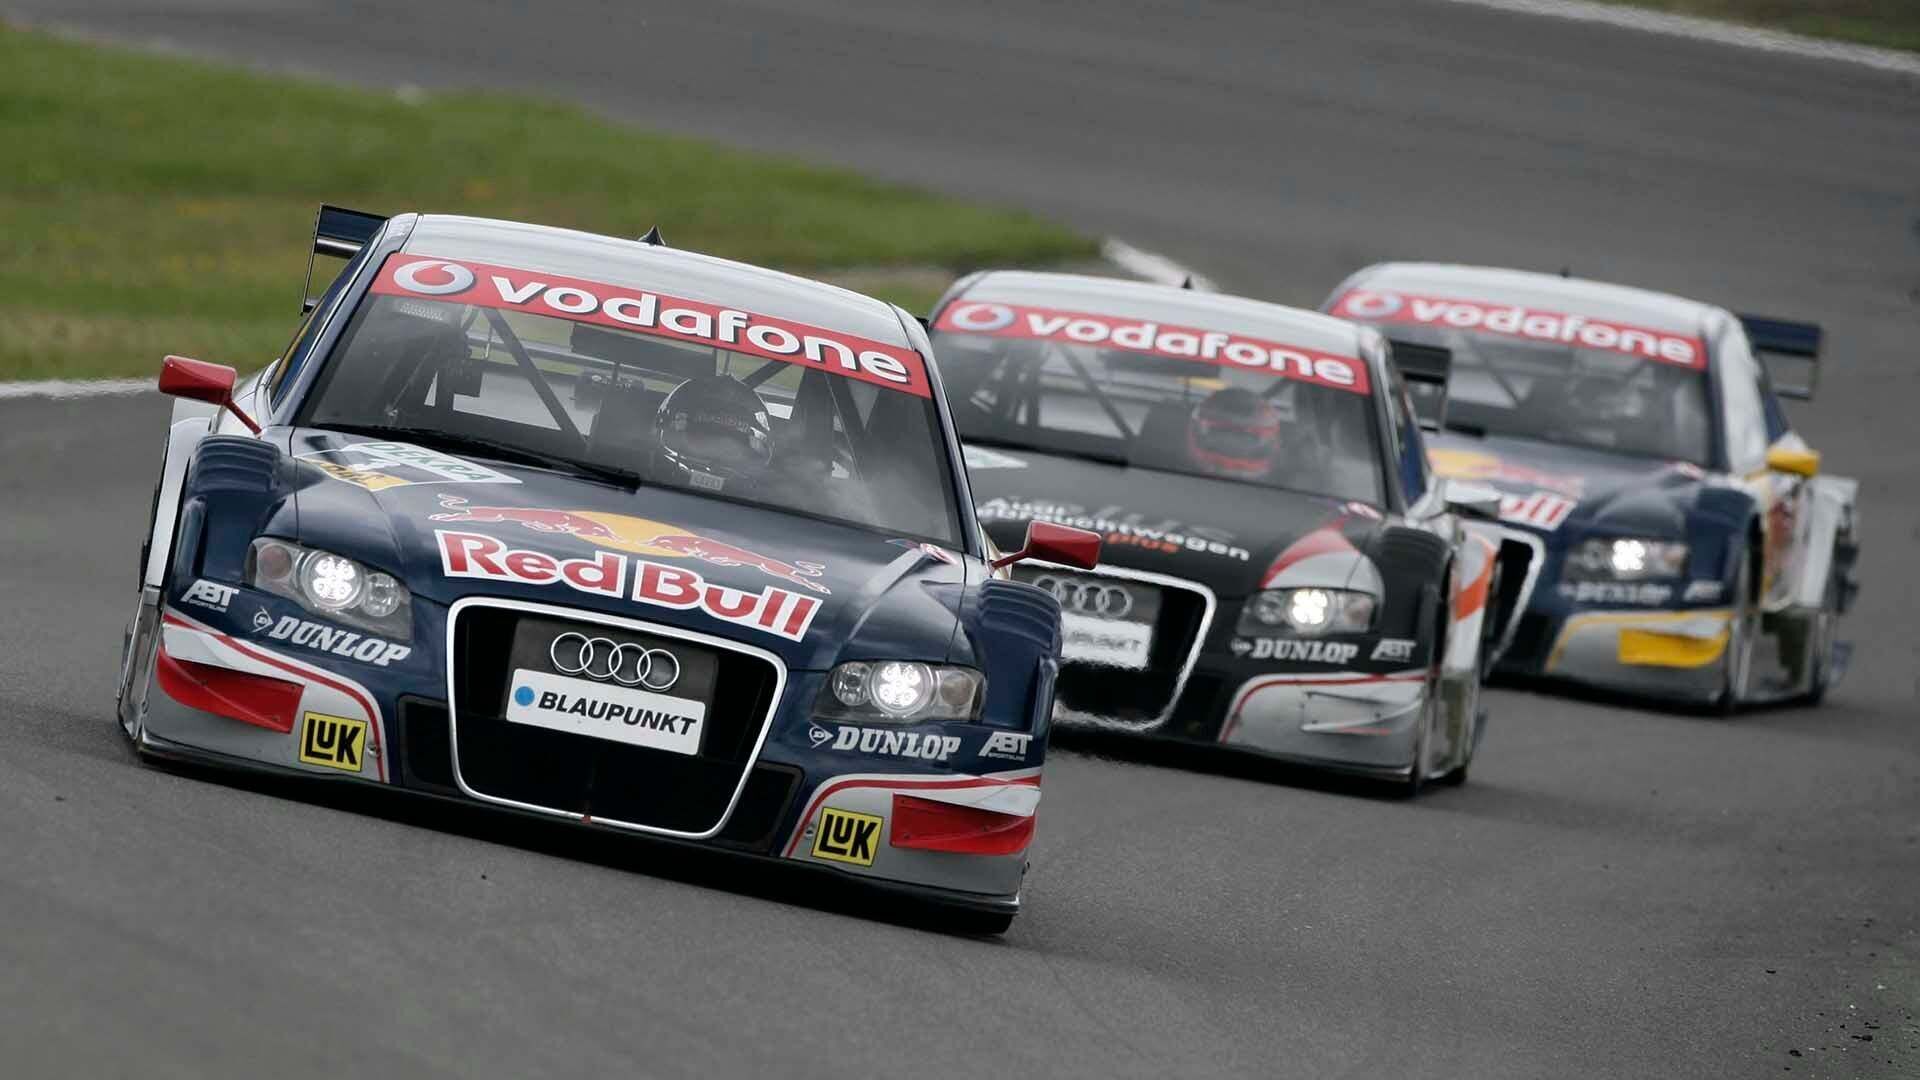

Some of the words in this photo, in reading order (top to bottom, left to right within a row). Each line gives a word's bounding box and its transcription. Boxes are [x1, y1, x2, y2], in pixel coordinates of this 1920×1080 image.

[491, 275, 910, 384] vodafone
[1027, 314, 1356, 385] vodafone
[1412, 300, 1695, 364] vodafone
[180, 579, 240, 607] ABT
[436, 530, 627, 597] Red
[634, 561, 821, 641] Bull
[268, 615, 412, 667] DUNLOP
[1252, 638, 1359, 664] DUNLOP
[1370, 638, 1416, 660] ABT
[538, 691, 697, 735] BLAUPUNKT
[831, 726, 961, 761] DUNLOP
[978, 731, 1033, 756] ABT
